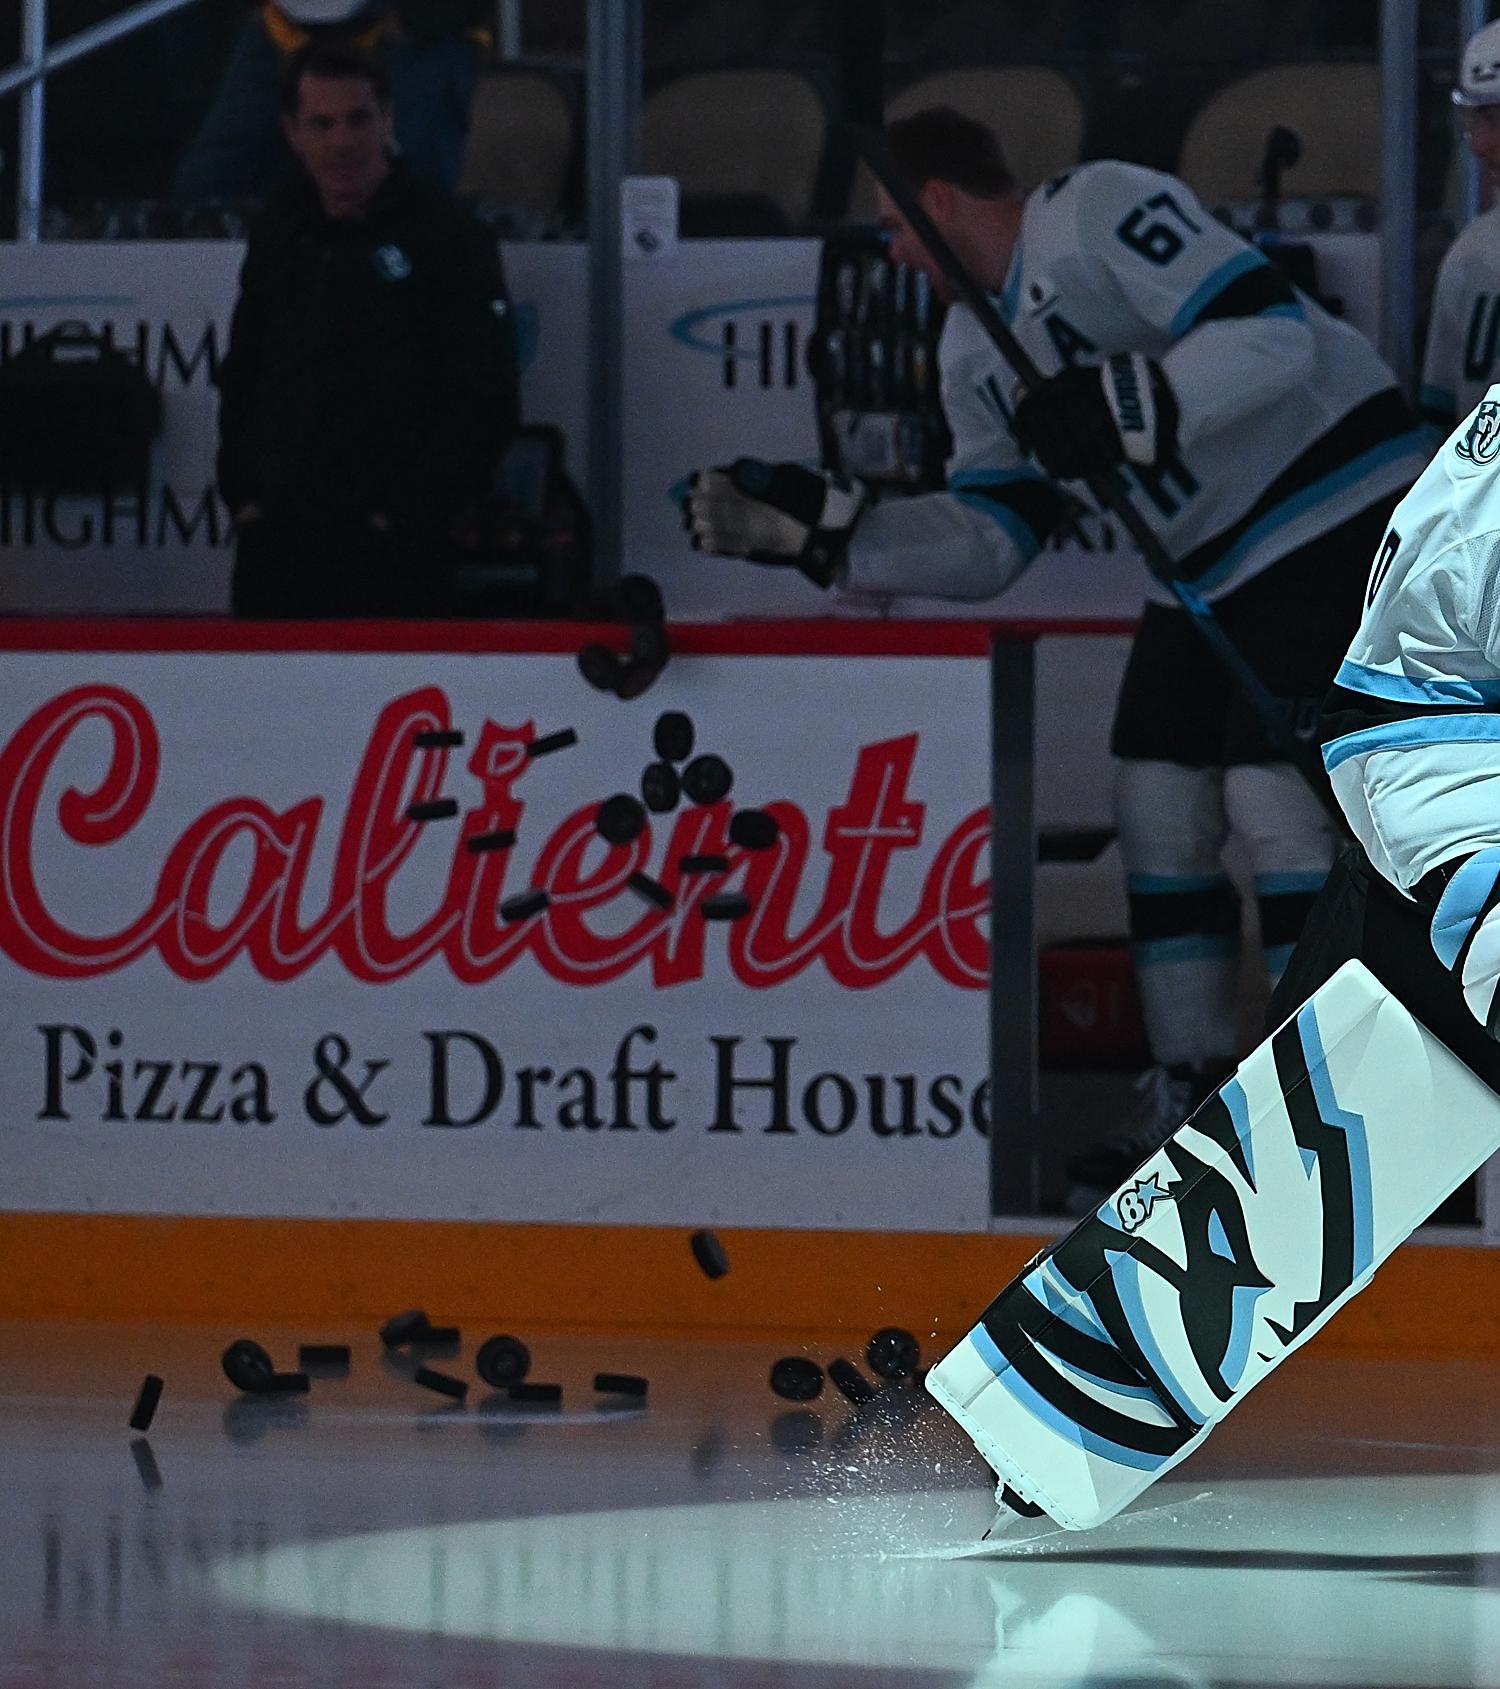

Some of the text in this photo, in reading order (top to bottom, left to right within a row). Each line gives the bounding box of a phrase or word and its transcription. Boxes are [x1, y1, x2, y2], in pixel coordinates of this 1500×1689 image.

[1117, 191, 1201, 266] 67
[37, 1023, 279, 1125] Pizza
[304, 1031, 392, 1127] &
[421, 1023, 677, 1131] Draft
